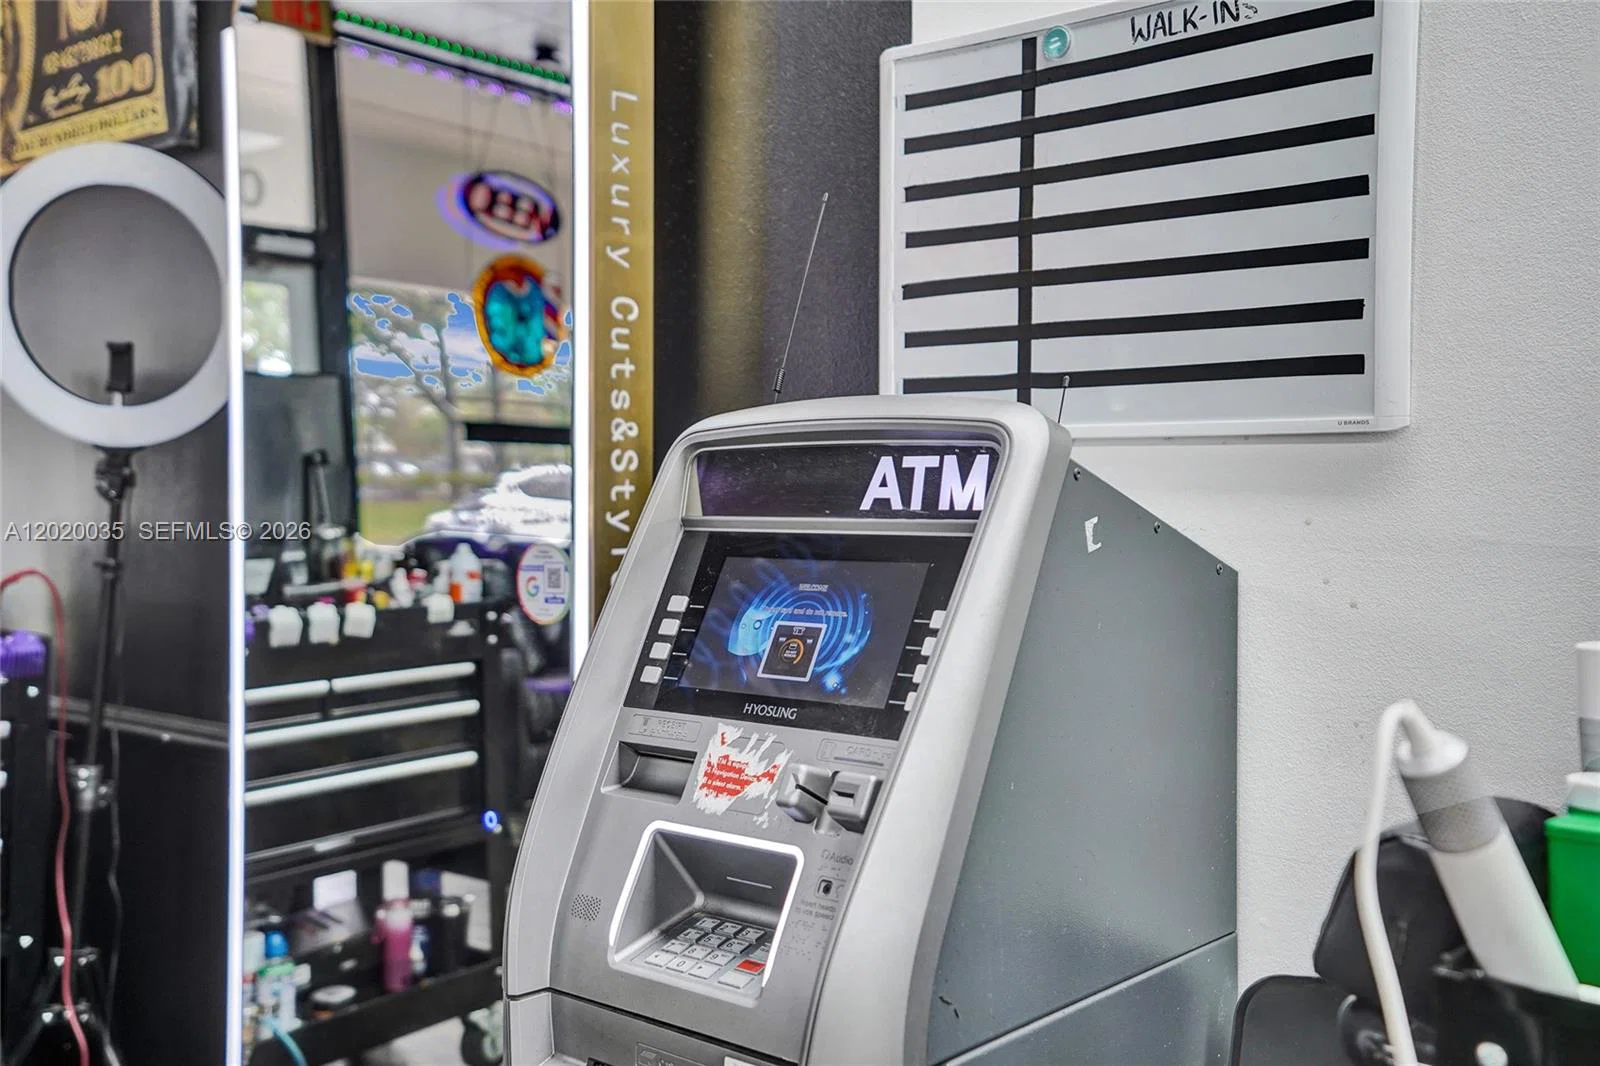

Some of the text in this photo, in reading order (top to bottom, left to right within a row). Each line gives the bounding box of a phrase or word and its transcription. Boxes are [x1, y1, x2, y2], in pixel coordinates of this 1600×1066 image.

[95, 52, 154, 103] 100
[605, 89, 640, 588] Luxury Cuts&Styl
[859, 454, 990, 512] ATM
[743, 702, 798, 721] HYOSUNG
[829, 852, 854, 866] Audio
